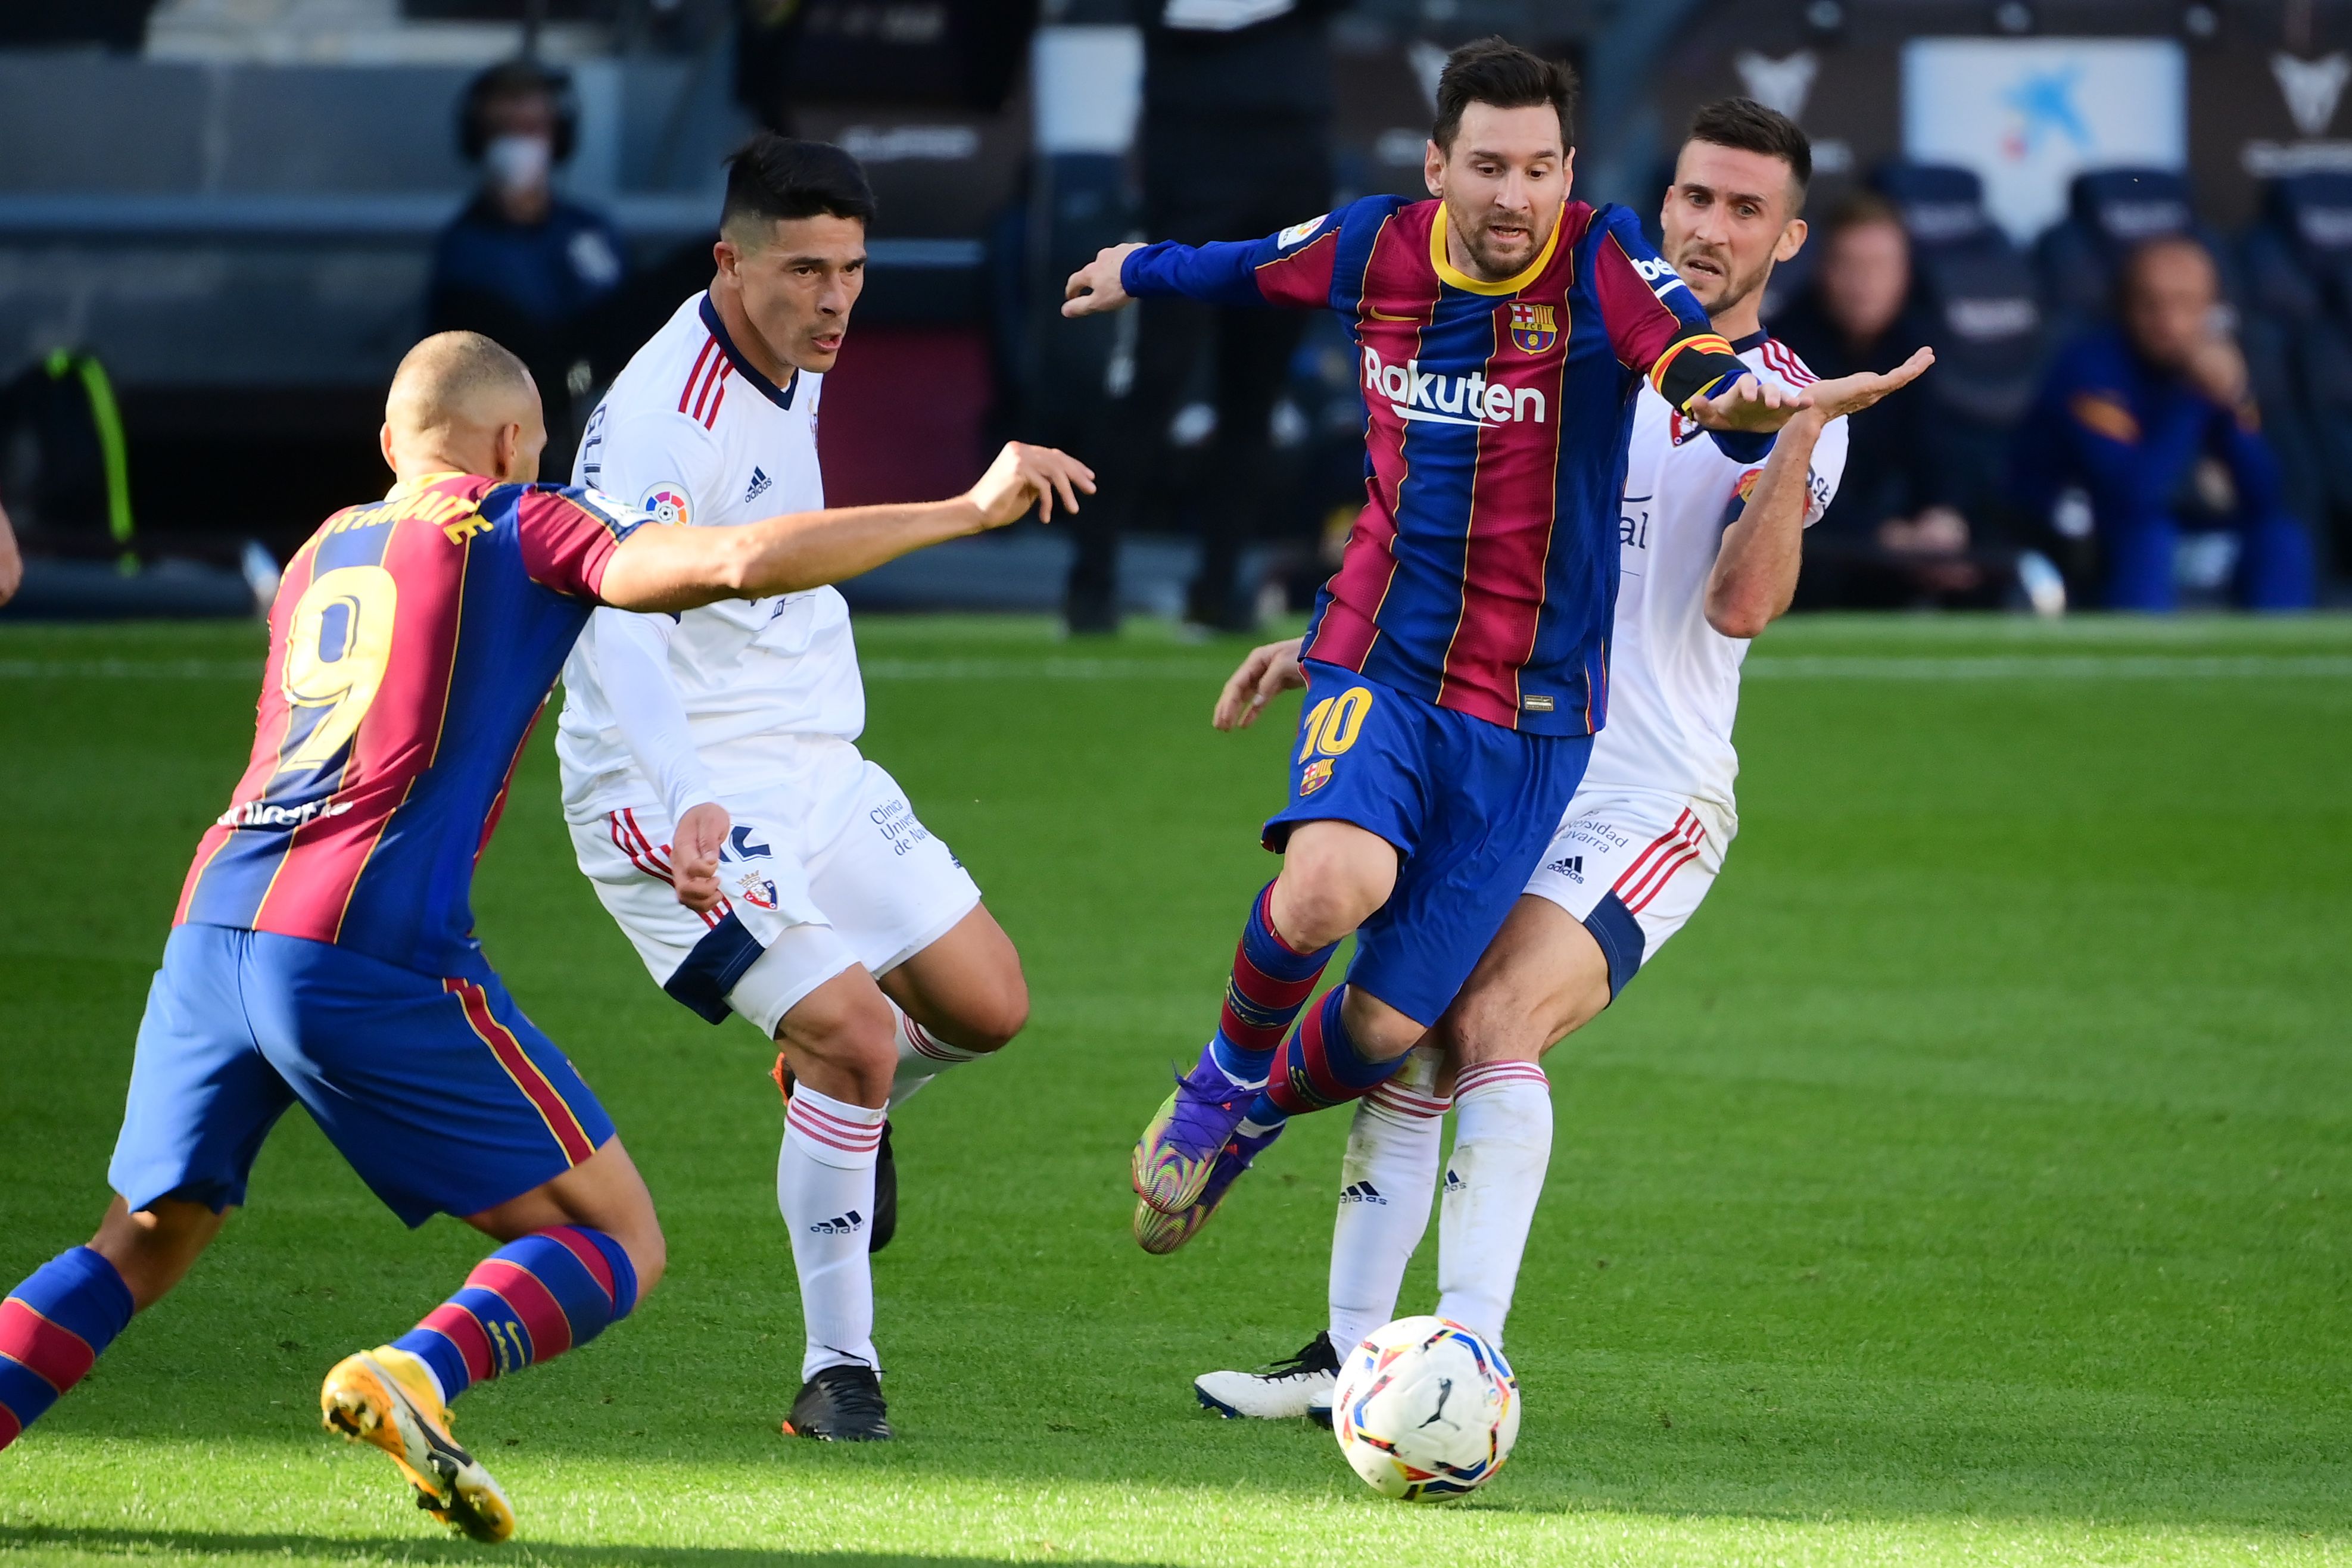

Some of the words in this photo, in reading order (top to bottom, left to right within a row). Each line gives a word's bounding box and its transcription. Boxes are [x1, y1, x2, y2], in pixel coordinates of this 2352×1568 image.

[1364, 345, 1546, 423] Rakuten
[744, 477, 772, 503] adidas
[281, 565, 398, 773] 9
[1298, 686, 1373, 766] 10
[894, 838, 912, 856] de
[1547, 862, 1585, 885] adidas
